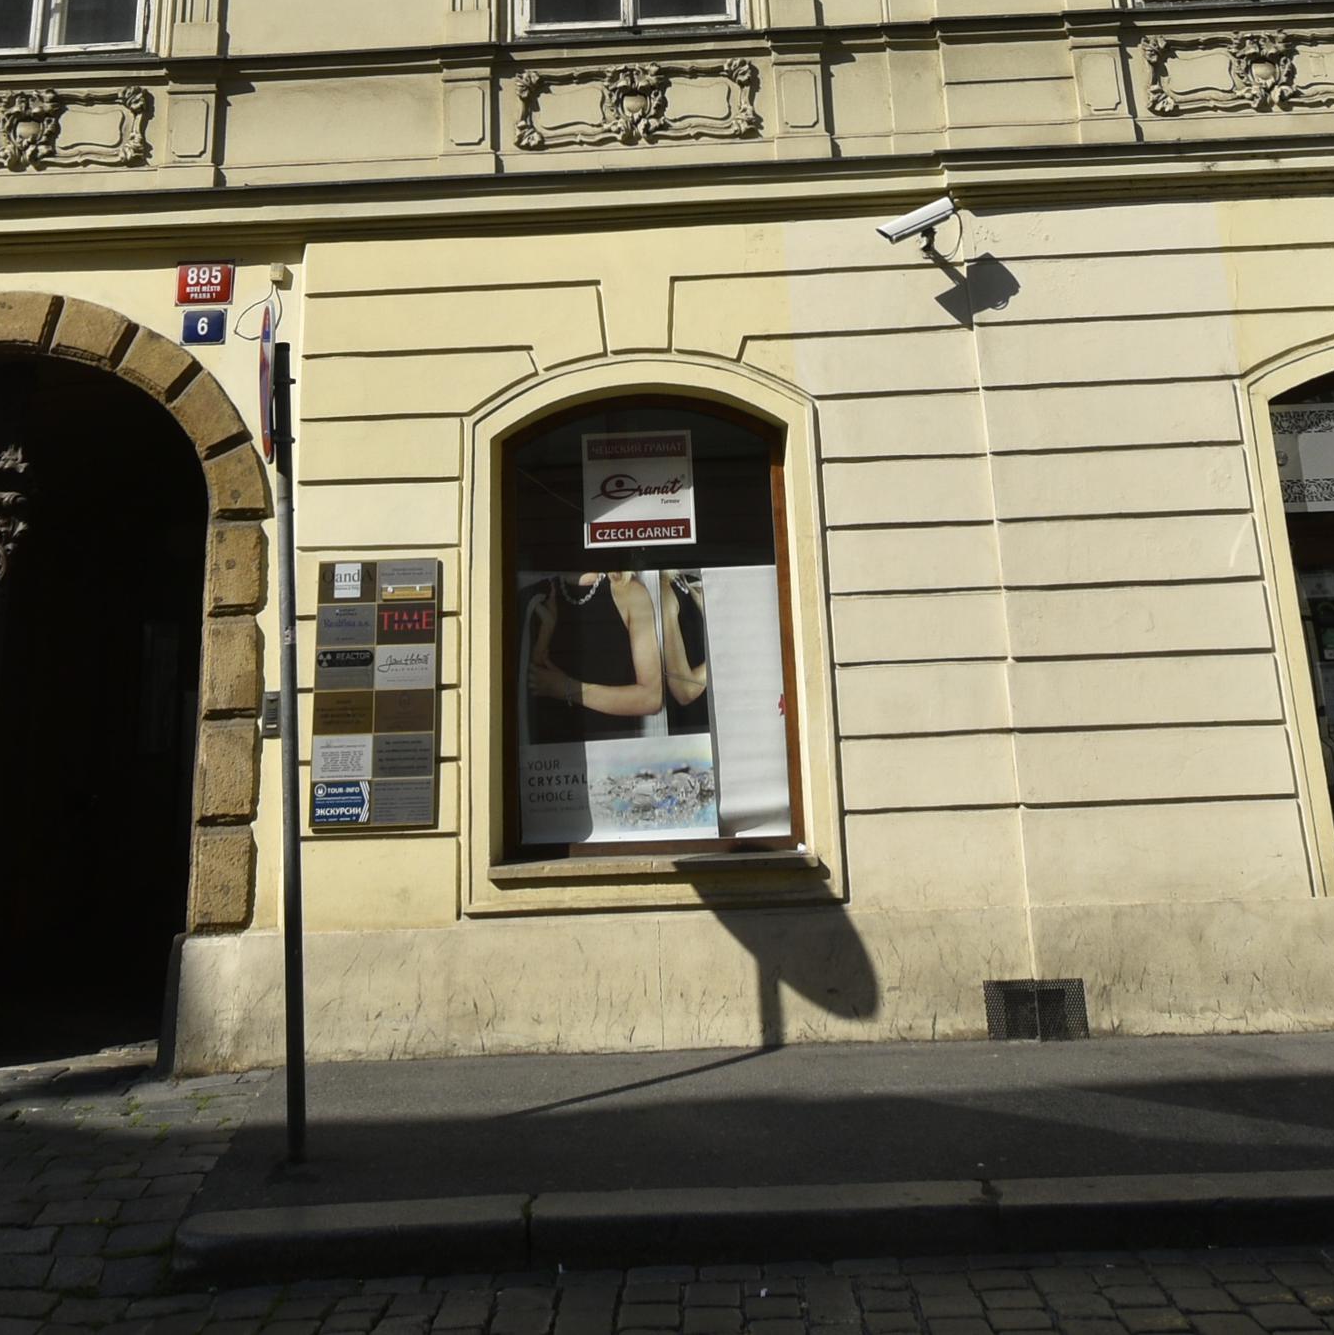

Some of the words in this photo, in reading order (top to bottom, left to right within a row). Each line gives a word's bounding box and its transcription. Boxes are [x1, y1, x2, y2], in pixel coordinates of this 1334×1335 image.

[187, 266, 222, 285] 895
[196, 316, 209, 336] 6
[595, 528, 634, 540] CZECH
[636, 526, 685, 539] GARNET
[379, 609, 436, 631] TIME
[336, 652, 371, 660] REACTOR
[527, 759, 560, 772] YOUR
[528, 773, 587, 787] CRYSTAL
[529, 790, 574, 803] CHOICE
[315, 806, 362, 817] ЭКСКУРСИИ
